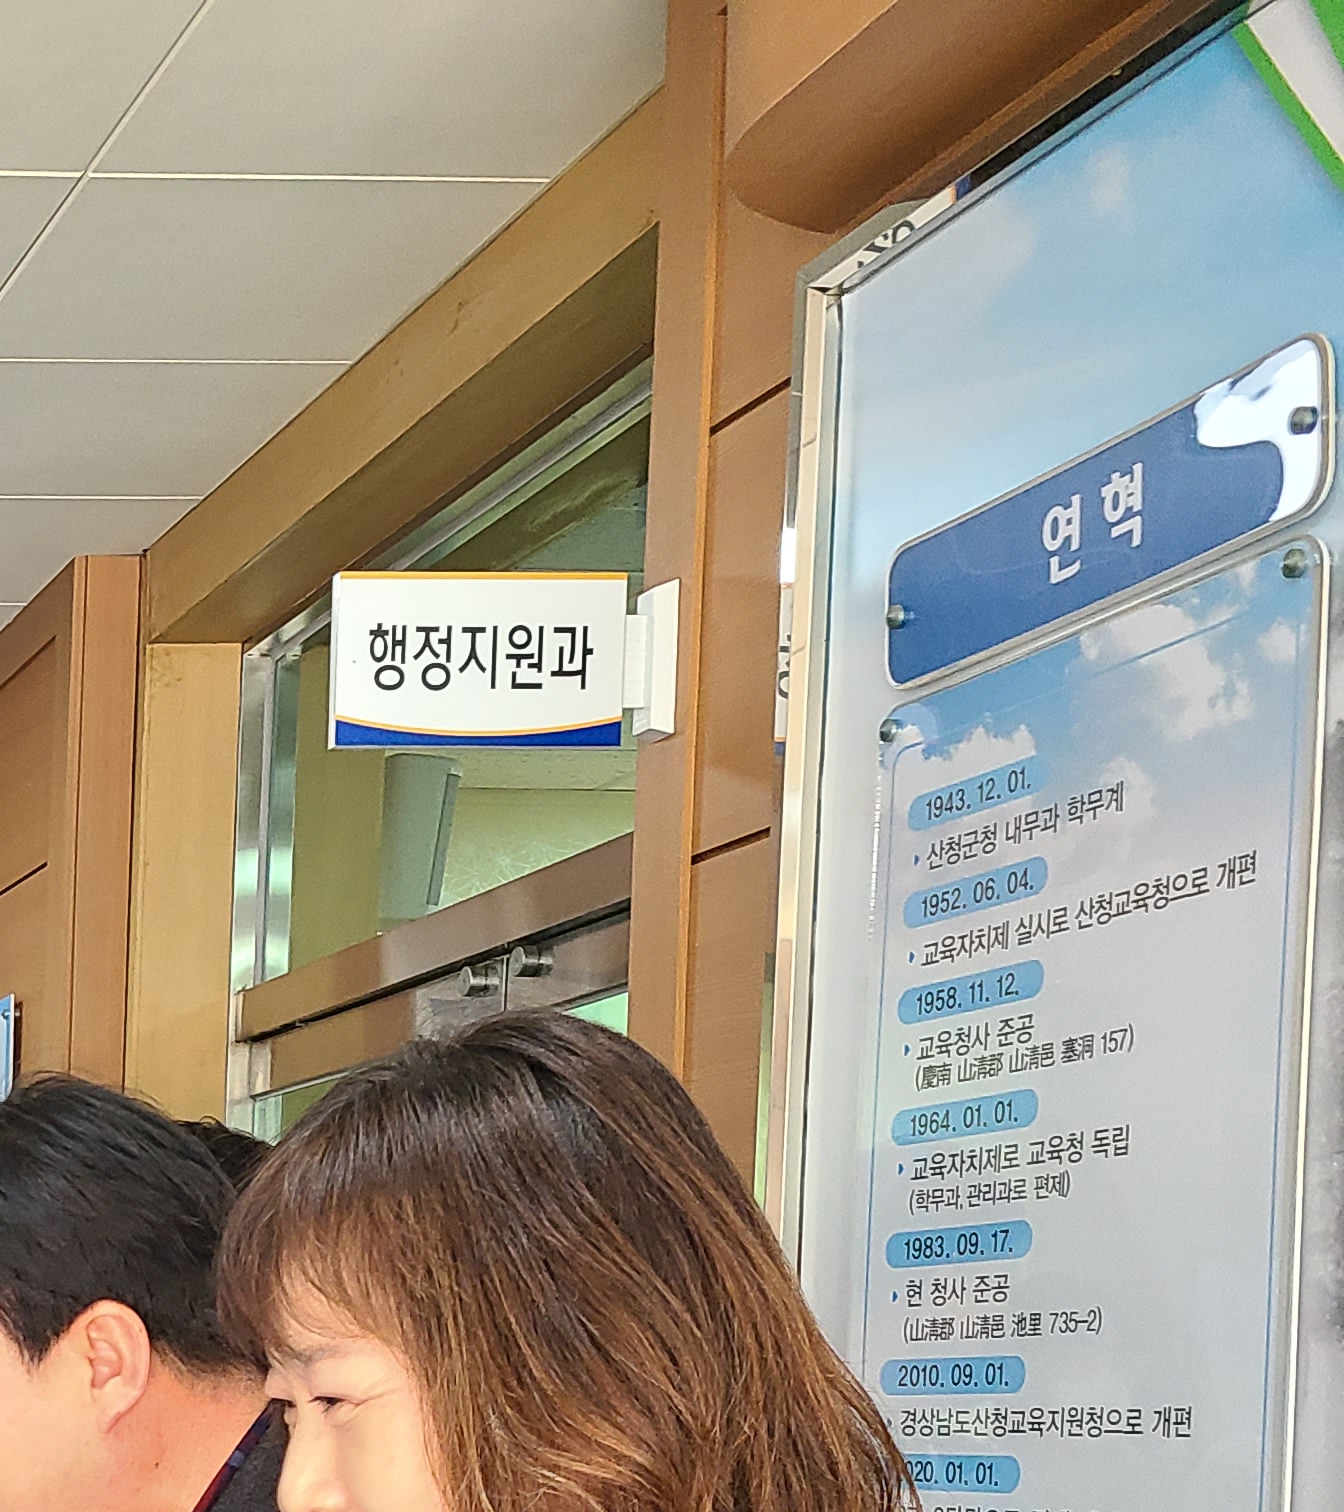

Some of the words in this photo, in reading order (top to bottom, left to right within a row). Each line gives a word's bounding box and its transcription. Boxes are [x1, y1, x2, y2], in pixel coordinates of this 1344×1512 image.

[368, 622, 595, 691] 행정지원과
[925, 788, 971, 821] 1943.
[977, 779, 1002, 804] 12.
[1007, 766, 1032, 792] 01.
[926, 822, 998, 870] 산청군청
[1005, 802, 1060, 844] 내무과
[1068, 780, 1125, 825] 학무계
[920, 887, 966, 918] 1952.
[973, 878, 1000, 904] 06.
[1006, 866, 1034, 894] 04.
[920, 919, 1010, 967] 교육자치제
[1014, 906, 1070, 949] 실시로
[1074, 867, 1210, 931] 산청교육청으로
[1216, 849, 1258, 889] 개편
[916, 987, 962, 1016] 1958.
[969, 979, 990, 1004] 11.
[997, 972, 1020, 998] 12.
[916, 1021, 990, 1060] 교육청사
[996, 1014, 1035, 1048] 준공
[1101, 1023, 1134, 1054] 157)
[909, 1110, 957, 1137] 1964.
[963, 1105, 987, 1129] 01.
[994, 1100, 1019, 1124] 01.
[910, 1143, 1020, 1181] 교육자치제로
[1027, 1131, 1085, 1166] 교육청
[1091, 1124, 1131, 1157] 독립
[966, 1178, 1027, 1208] 관리과로
[1033, 1170, 1071, 1199] 편제)
[903, 1238, 951, 1260] 1983.
[957, 1232, 985, 1256] 09.
[991, 1229, 1013, 1253] 17.
[905, 1279, 922, 1307] 현
[929, 1276, 968, 1306] 청사
[972, 1273, 1011, 1304] 준공
[897, 1364, 945, 1388] 2010.
[951, 1363, 978, 1387] 09.
[985, 1362, 1009, 1387] 01.
[899, 1406, 1144, 1439] 경상남도산청교육지원청으로
[1151, 1405, 1193, 1438] 개편
[946, 1462, 969, 1486] 01.
[975, 1462, 999, 1487] 01.
